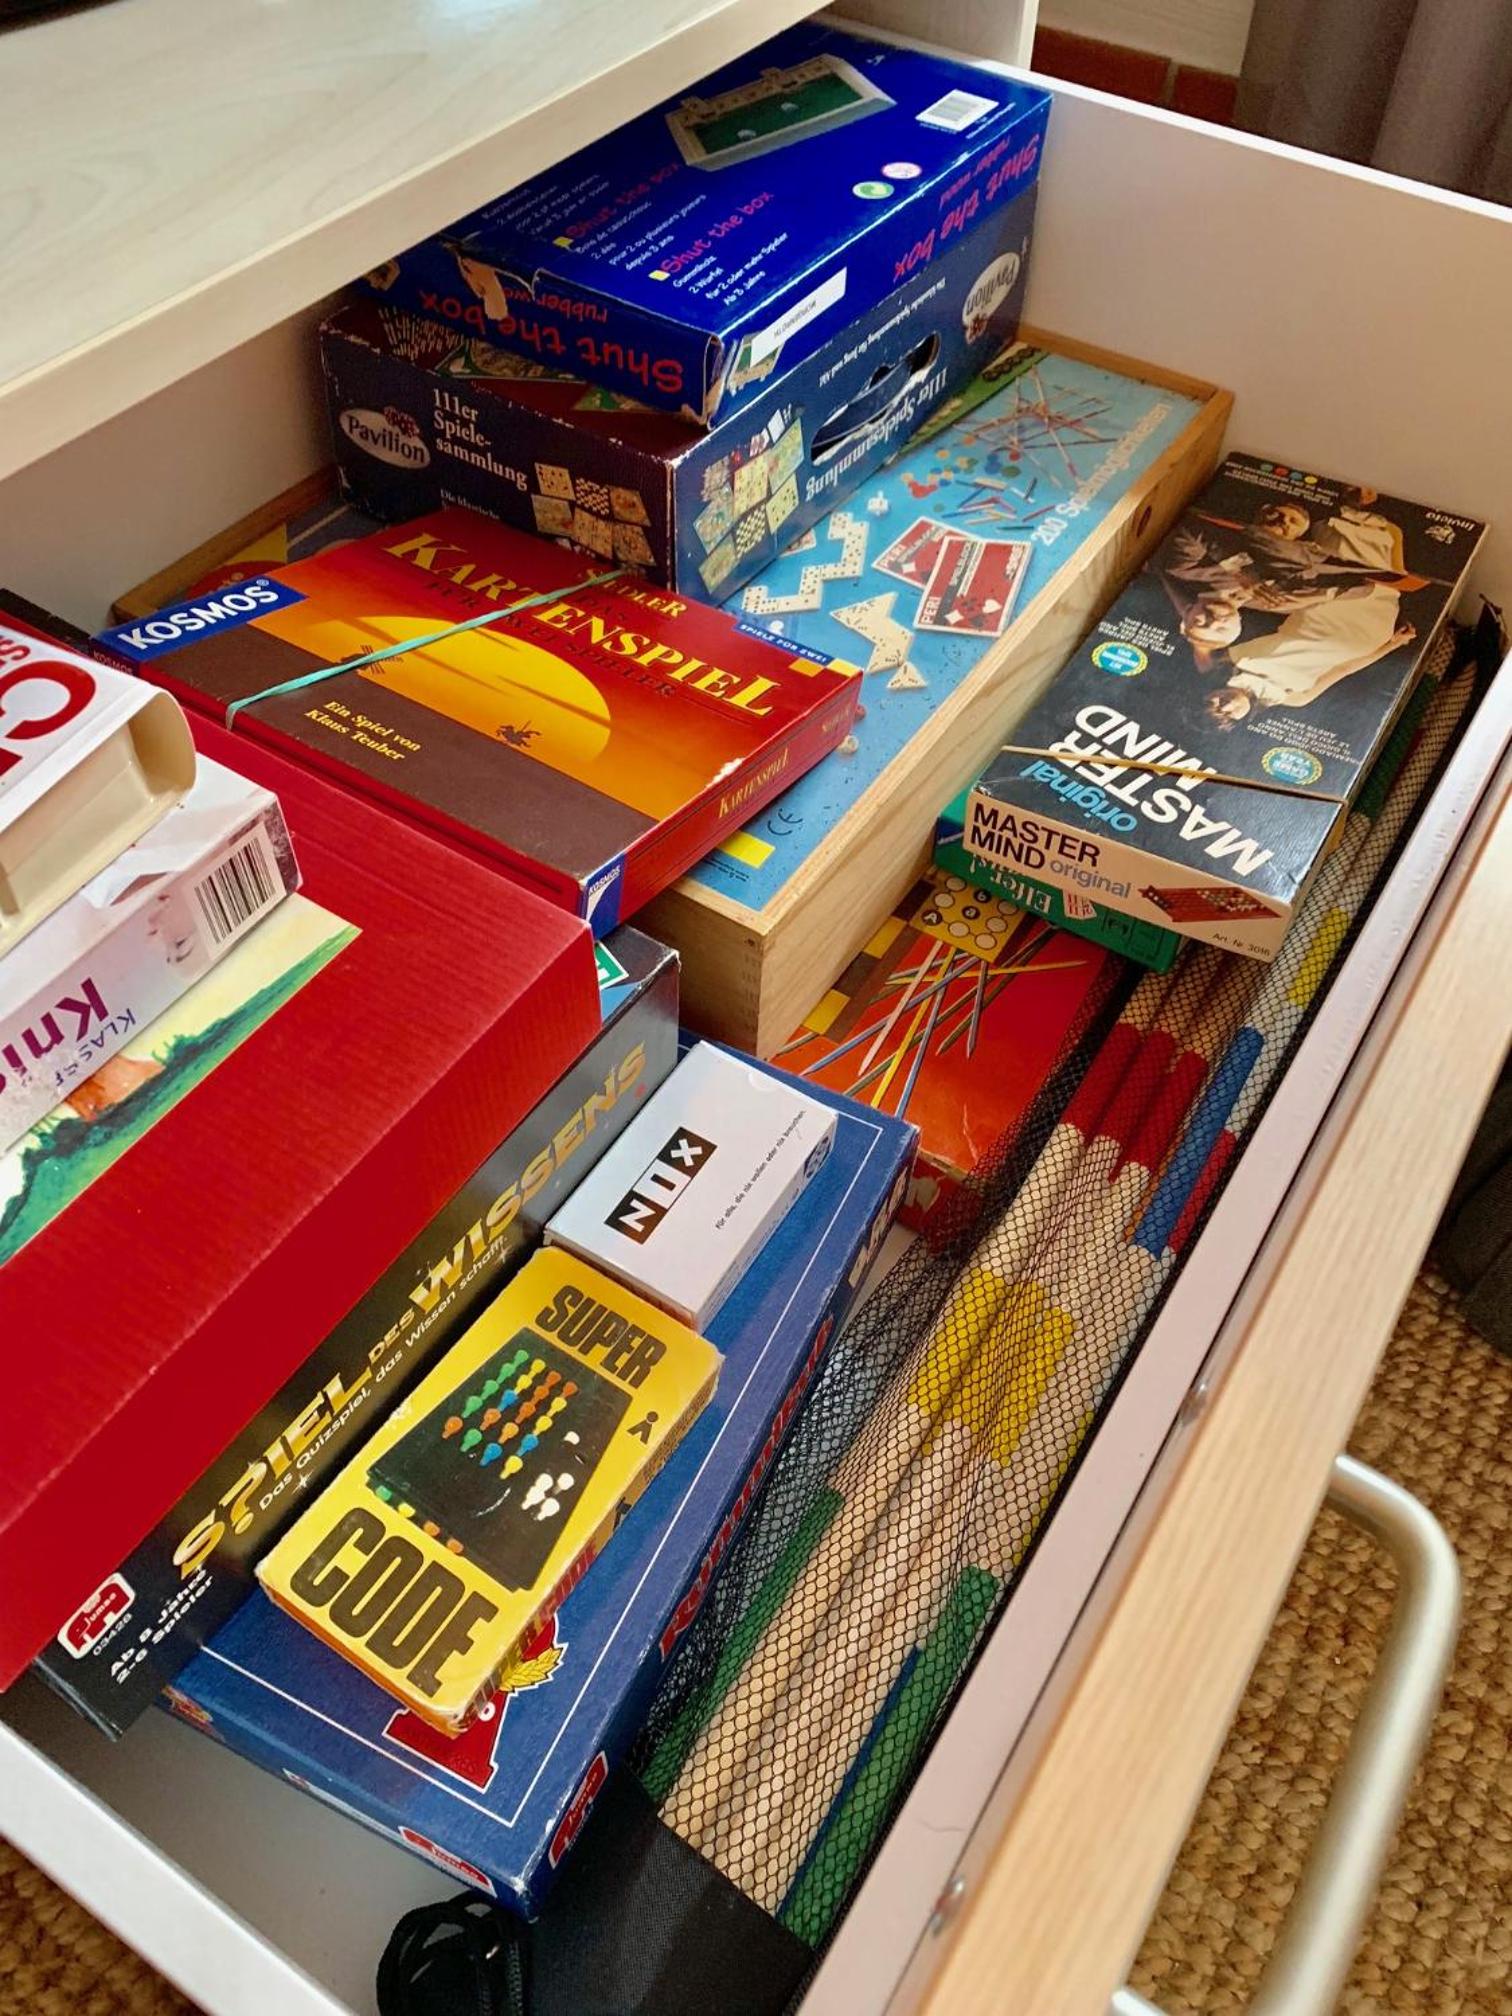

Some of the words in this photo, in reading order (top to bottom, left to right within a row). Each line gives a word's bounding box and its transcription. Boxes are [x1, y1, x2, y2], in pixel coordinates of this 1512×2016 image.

[985, 133, 1039, 202] Shut
[661, 239, 712, 273] Shut
[708, 213, 743, 239] the
[736, 191, 776, 216] box
[939, 190, 980, 238] the
[894, 229, 936, 284] box
[419, 290, 487, 335] box
[537, 293, 608, 323] rubber
[966, 268, 1017, 316] Pavilion
[499, 316, 568, 353] the
[577, 337, 684, 394] Shut
[432, 410, 493, 449] Spiele-
[433, 388, 480, 423] 111er
[346, 415, 427, 465] Pavilion
[435, 435, 530, 492] sammlung
[1030, 516, 1069, 547] 200
[383, 532, 782, 718] KARTENSPIEL
[920, 596, 943, 624] PERI
[739, 623, 776, 642] SPIELE
[799, 648, 827, 663] ZWEI
[305, 708, 352, 735] Klaus
[349, 729, 406, 762] Teuber
[322, 701, 350, 718] Ein
[348, 712, 395, 738] Spiel
[391, 732, 423, 753] von
[1074, 704, 1217, 793] MIND
[1019, 759, 1140, 832] original
[1048, 730, 1276, 878] MASTER
[970, 824, 1046, 870] MIND
[1048, 857, 1133, 900] original
[973, 802, 1102, 868] MASTER
[588, 865, 621, 896] KOSMOS
[990, 871, 1053, 915] Elfer
[0, 977, 109, 1095] Kni
[368, 1308, 416, 1364] DES
[408, 1040, 647, 1315] WISSENS
[535, 1285, 668, 1390] SUPER
[259, 1472, 293, 1512] Das
[295, 1388, 372, 1471] Quizspiel,
[375, 1351, 403, 1383] das
[404, 1292, 456, 1347] Wissen
[78, 1591, 118, 1641] Jumbo
[110, 1647, 135, 1677] Ab
[158, 1568, 207, 1625] Jahre
[151, 1576, 213, 1645] Spieler
[290, 1507, 500, 1698] CODE
